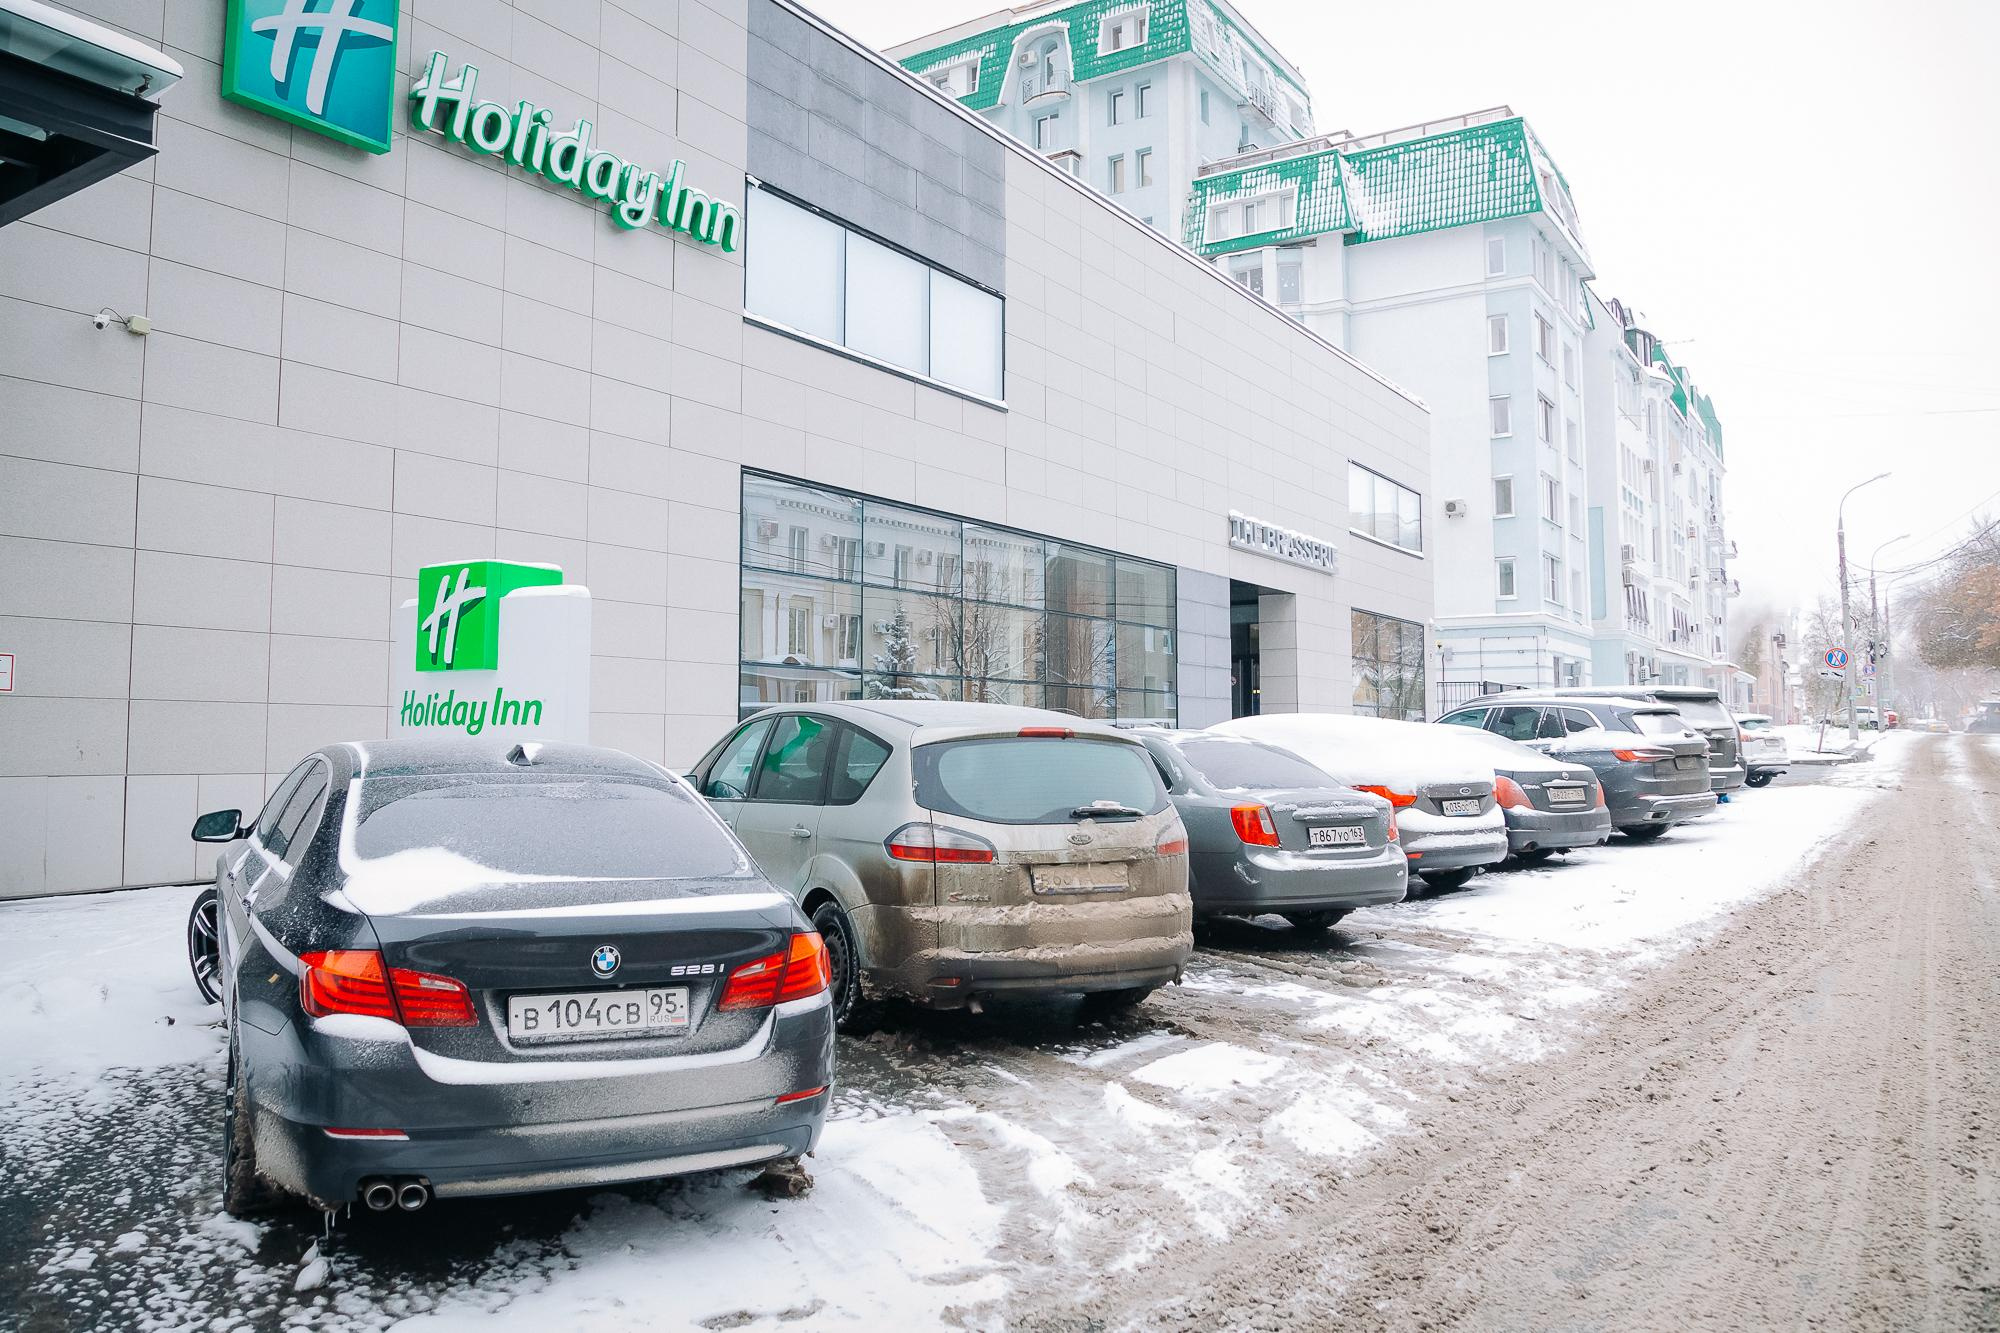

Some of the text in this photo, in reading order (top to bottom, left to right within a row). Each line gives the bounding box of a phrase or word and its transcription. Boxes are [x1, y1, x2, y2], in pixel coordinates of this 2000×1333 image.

[408, 50, 742, 253] Holiday Inn
[401, 687, 543, 735] Holiday Inn
[650, 992, 678, 1015] 95
[650, 1014, 671, 1024] RUS
